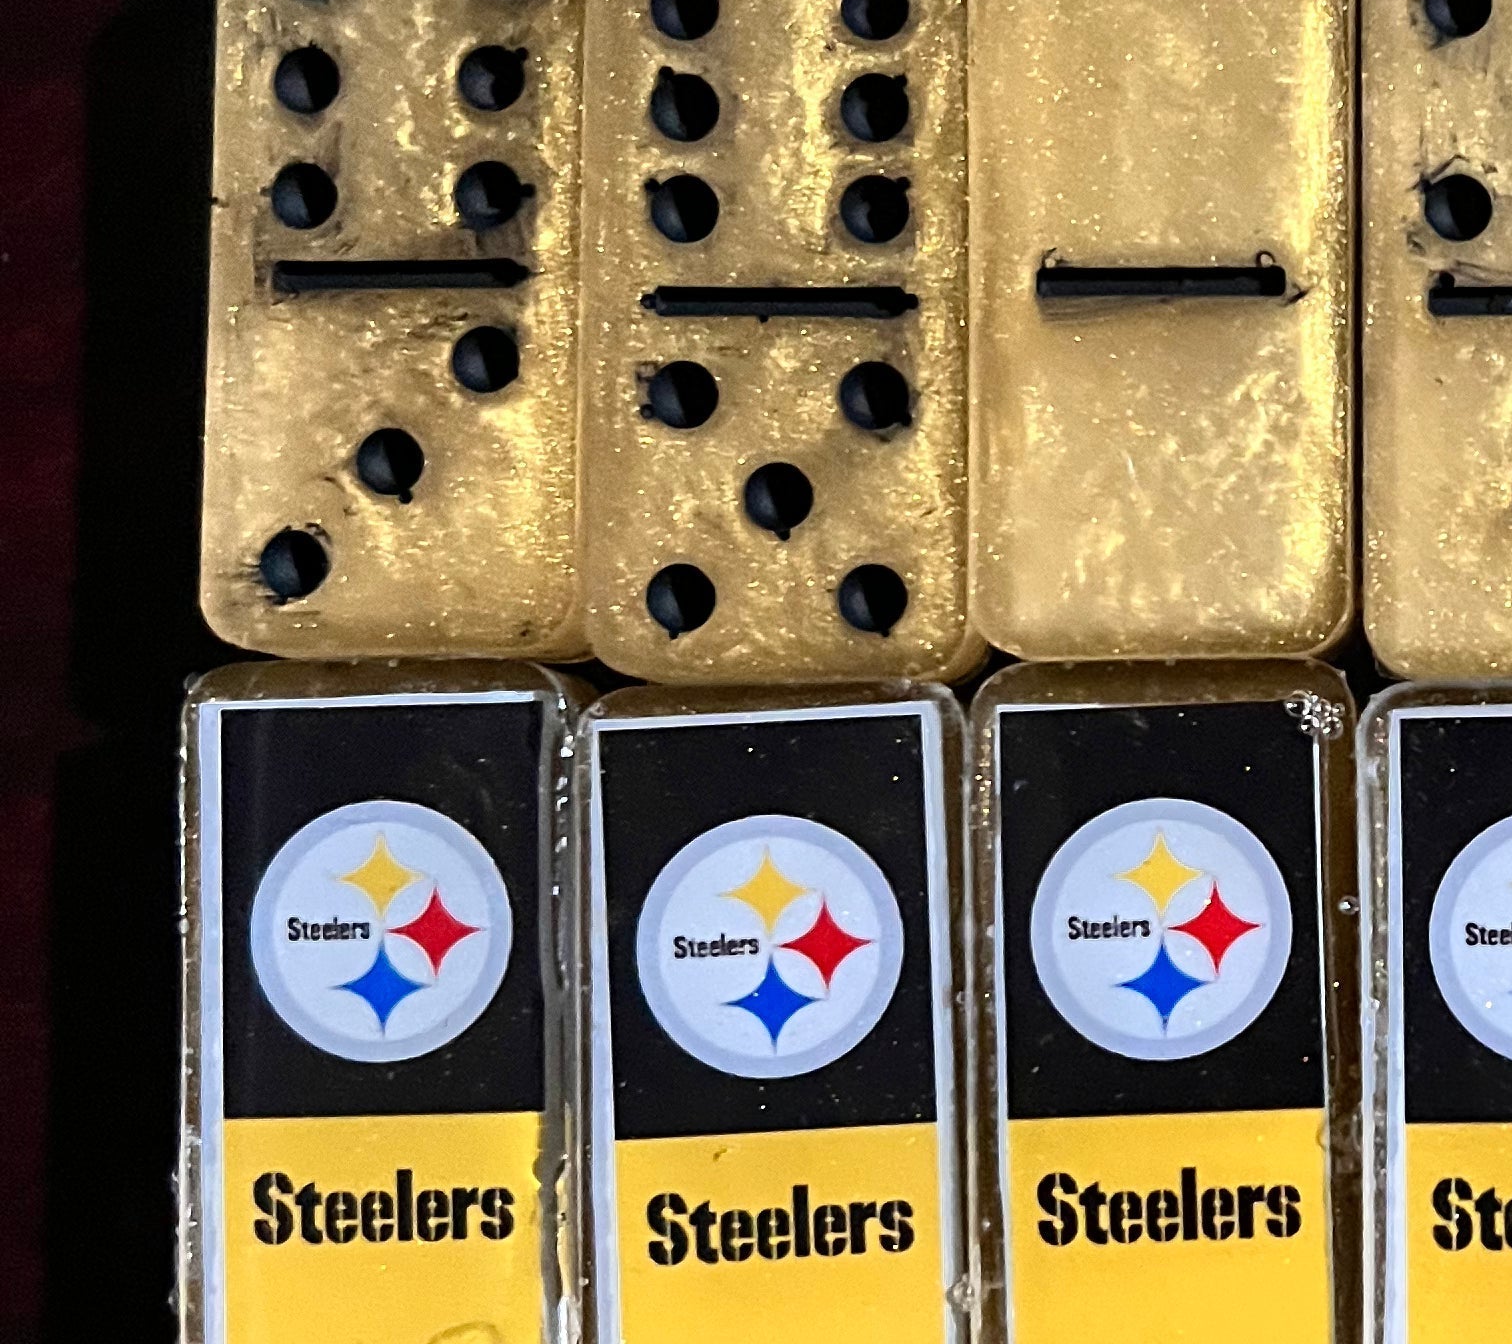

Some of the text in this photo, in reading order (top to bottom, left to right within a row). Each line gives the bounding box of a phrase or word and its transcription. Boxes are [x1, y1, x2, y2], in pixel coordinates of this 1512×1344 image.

[287, 915, 371, 943] Steelers
[673, 932, 759, 959] Steelers
[1068, 914, 1151, 940] Steelers
[253, 1169, 513, 1244] Steelers
[647, 1185, 914, 1265] Steelers
[1037, 1167, 1301, 1245] Steelers
